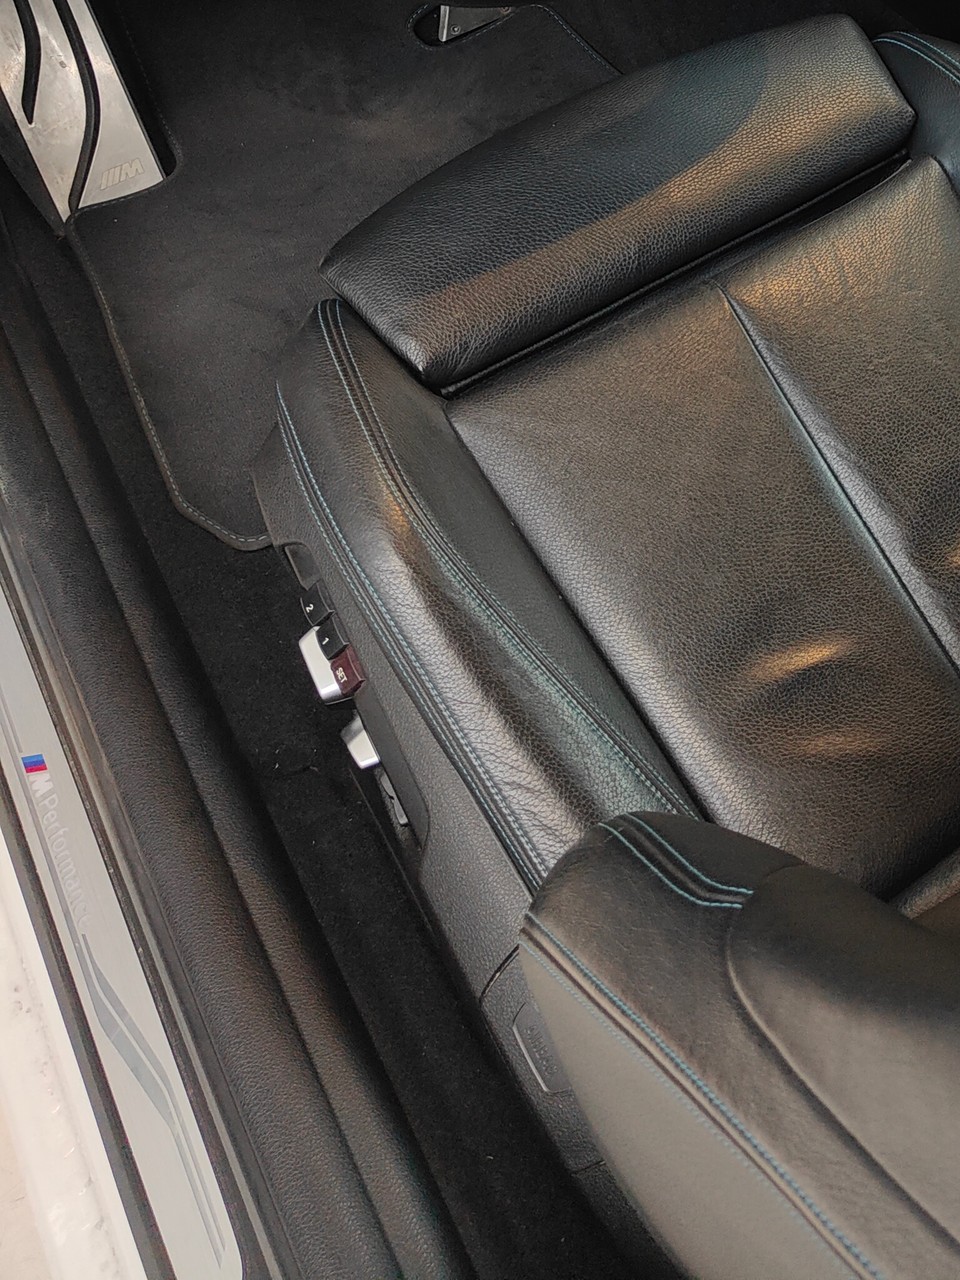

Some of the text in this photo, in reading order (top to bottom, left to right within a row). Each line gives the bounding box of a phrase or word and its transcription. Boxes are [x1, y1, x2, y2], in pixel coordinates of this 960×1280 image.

[305, 603, 314, 613] 2
[321, 637, 330, 646] 1
[335, 666, 348, 684] SET
